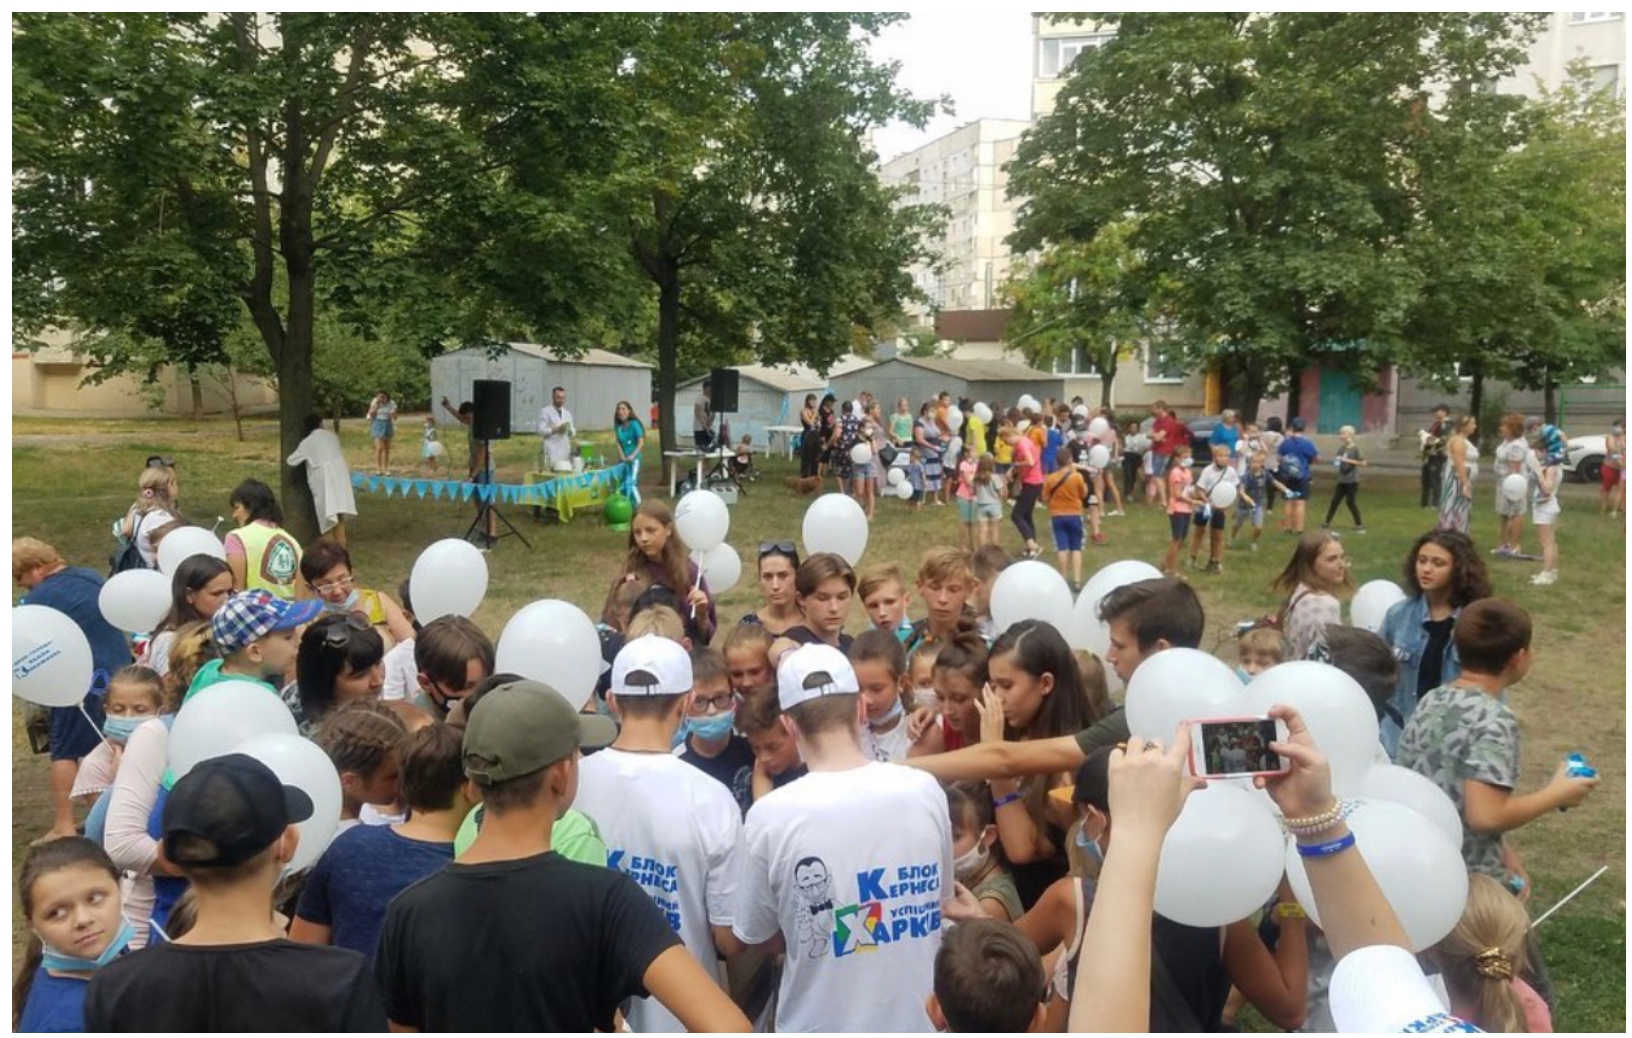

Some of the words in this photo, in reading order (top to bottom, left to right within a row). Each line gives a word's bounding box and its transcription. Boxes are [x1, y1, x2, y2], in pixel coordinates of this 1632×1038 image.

[631, 855, 678, 878] БЛОК
[897, 862, 939, 882] БЛОК
[832, 901, 941, 958] ХАРКІВ
